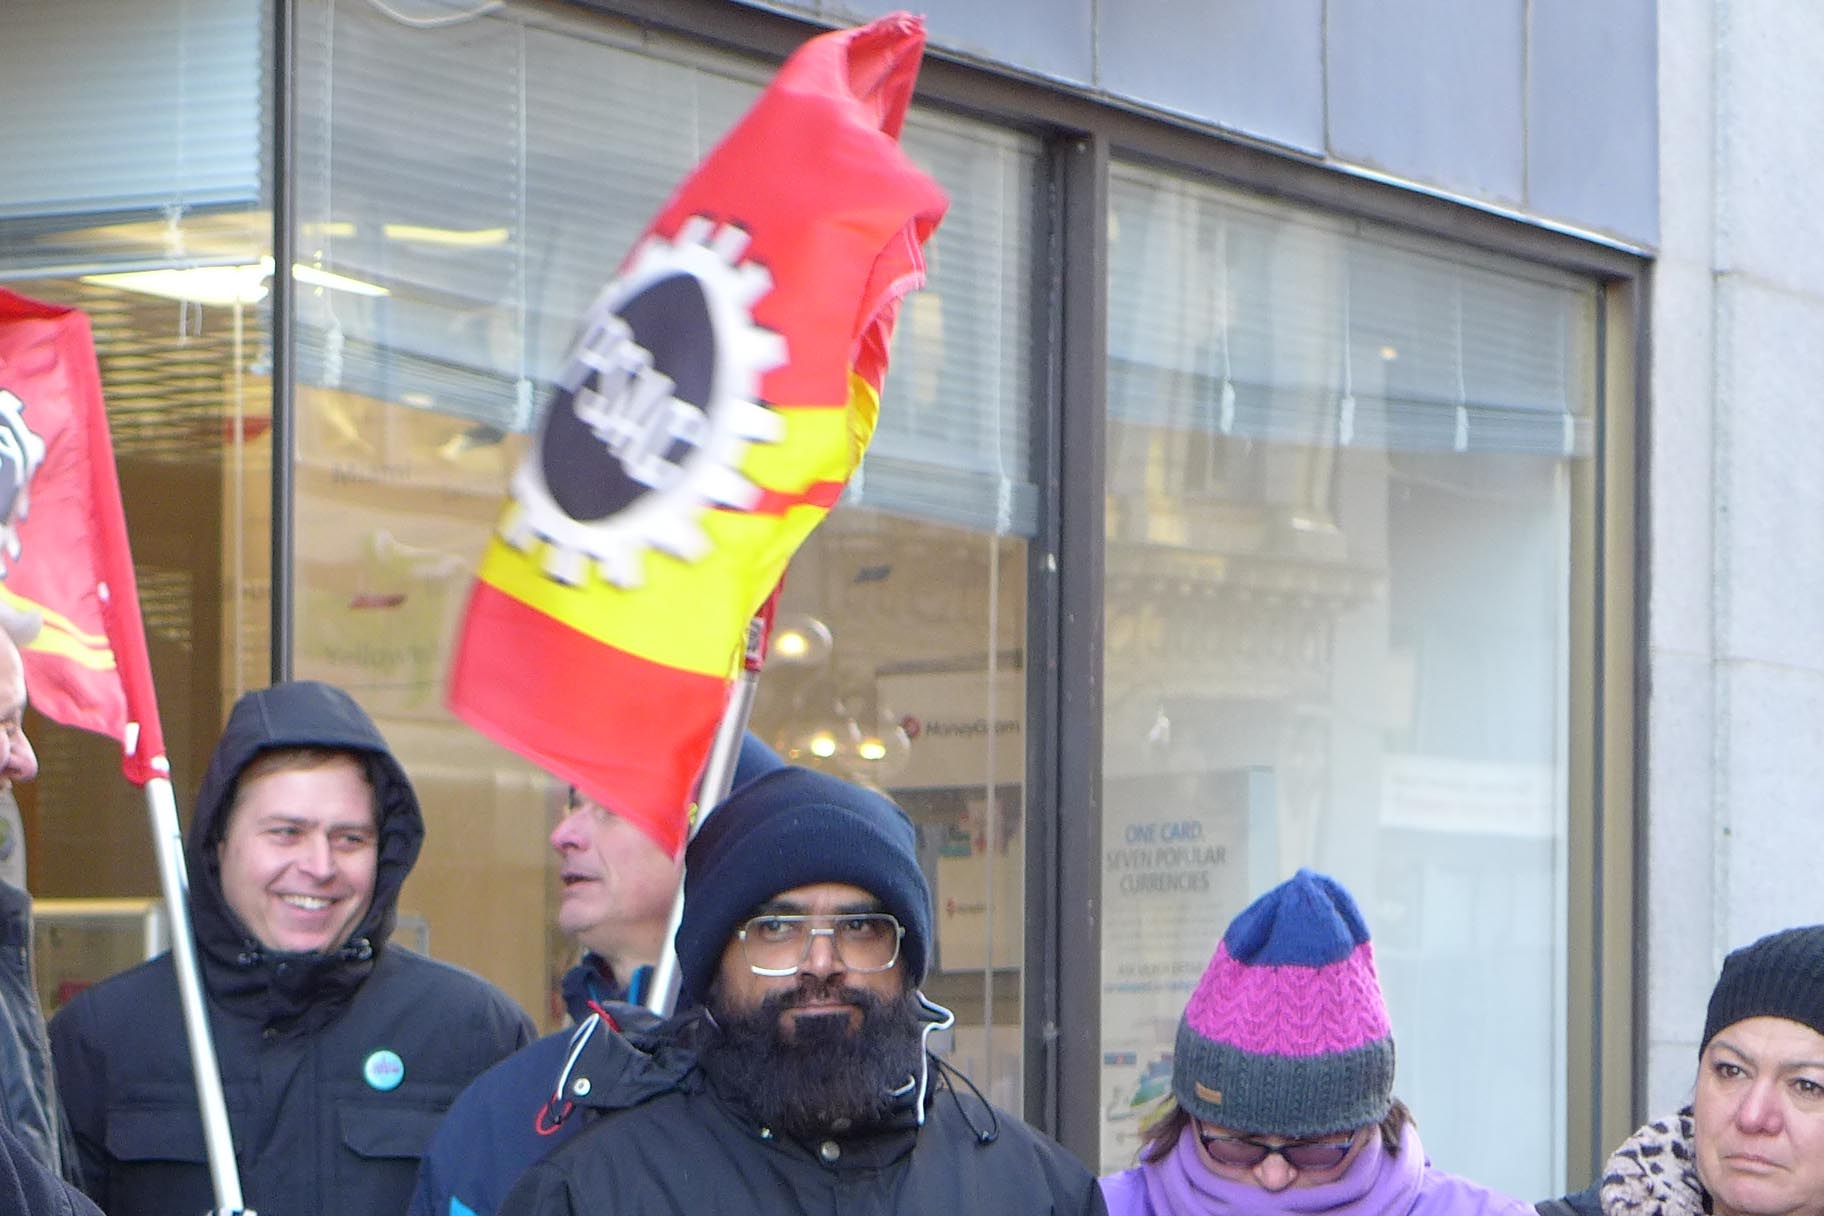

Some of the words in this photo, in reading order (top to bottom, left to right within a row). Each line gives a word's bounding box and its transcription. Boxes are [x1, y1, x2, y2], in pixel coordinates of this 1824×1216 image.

[1126, 823, 1155, 843] ONE
[1106, 849, 1152, 872] SEVEN
[1155, 846, 1227, 868] POPULAR
[1119, 870, 1210, 894] CURRENCIES
